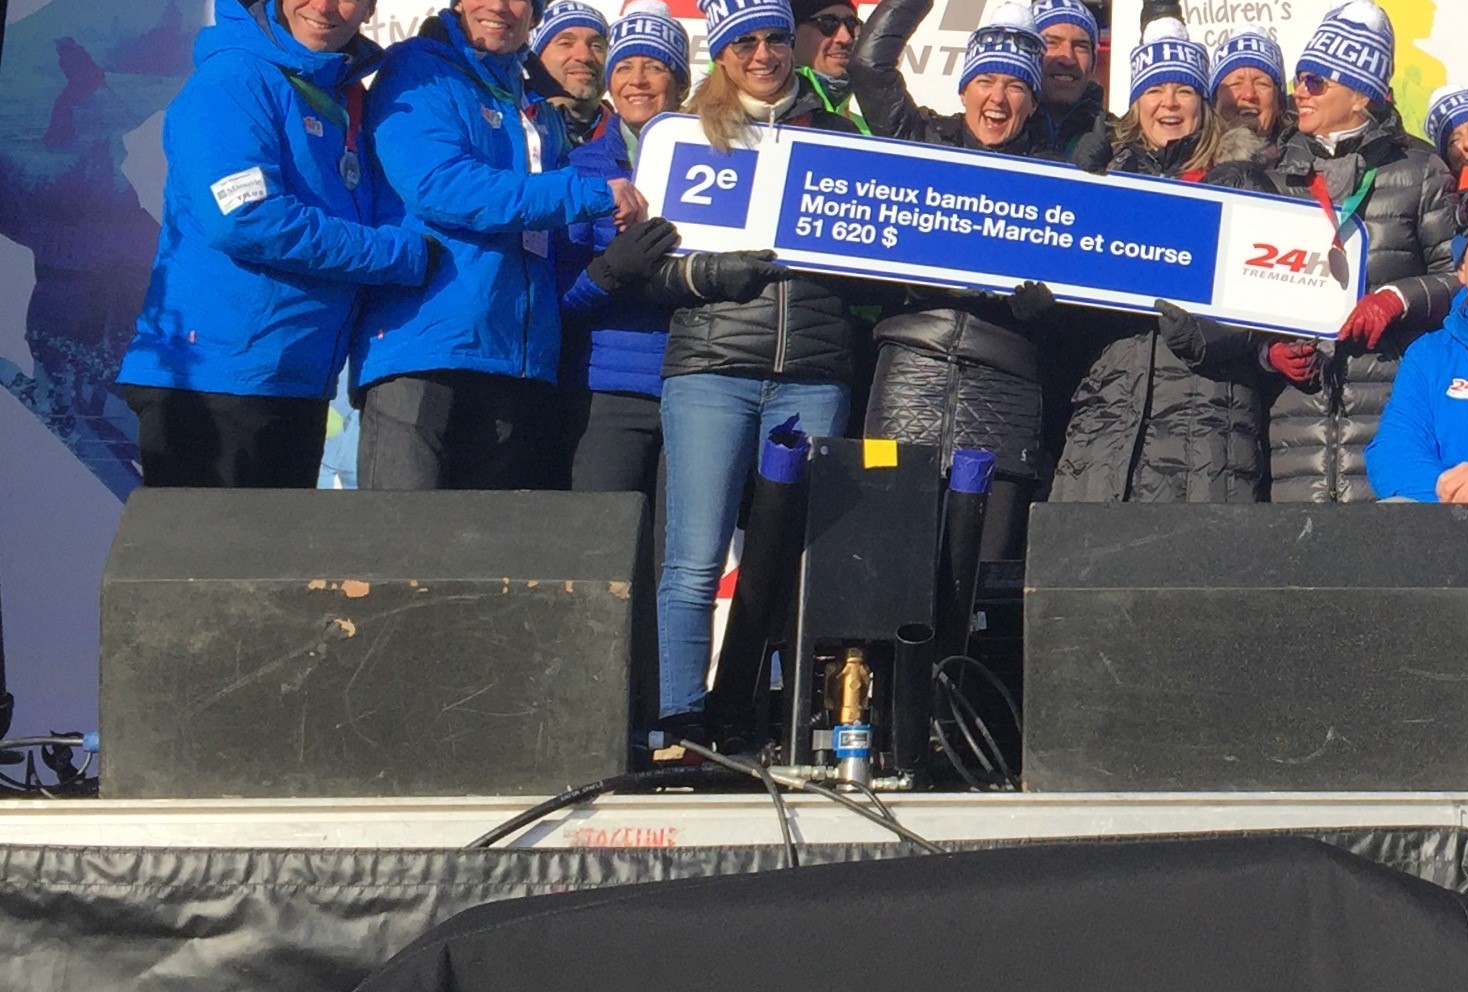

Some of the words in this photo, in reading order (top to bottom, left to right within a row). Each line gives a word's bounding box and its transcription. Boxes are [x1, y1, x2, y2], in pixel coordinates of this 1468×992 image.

[680, 164, 739, 206] 2e
[803, 170, 849, 195] Les
[855, 179, 919, 204] vieux
[924, 187, 1039, 221] bambous
[1044, 205, 1076, 226] de
[795, 216, 824, 238] 51
[831, 221, 877, 244] 620
[881, 225, 899, 249] $
[799, 192, 872, 221] Morin
[878, 203, 1074, 248] Heights-Marche
[1079, 235, 1105, 253] et
[1109, 240, 1193, 266] course
[1242, 267, 1327, 288] TREMBLANT
[1244, 243, 1330, 279] 24h
